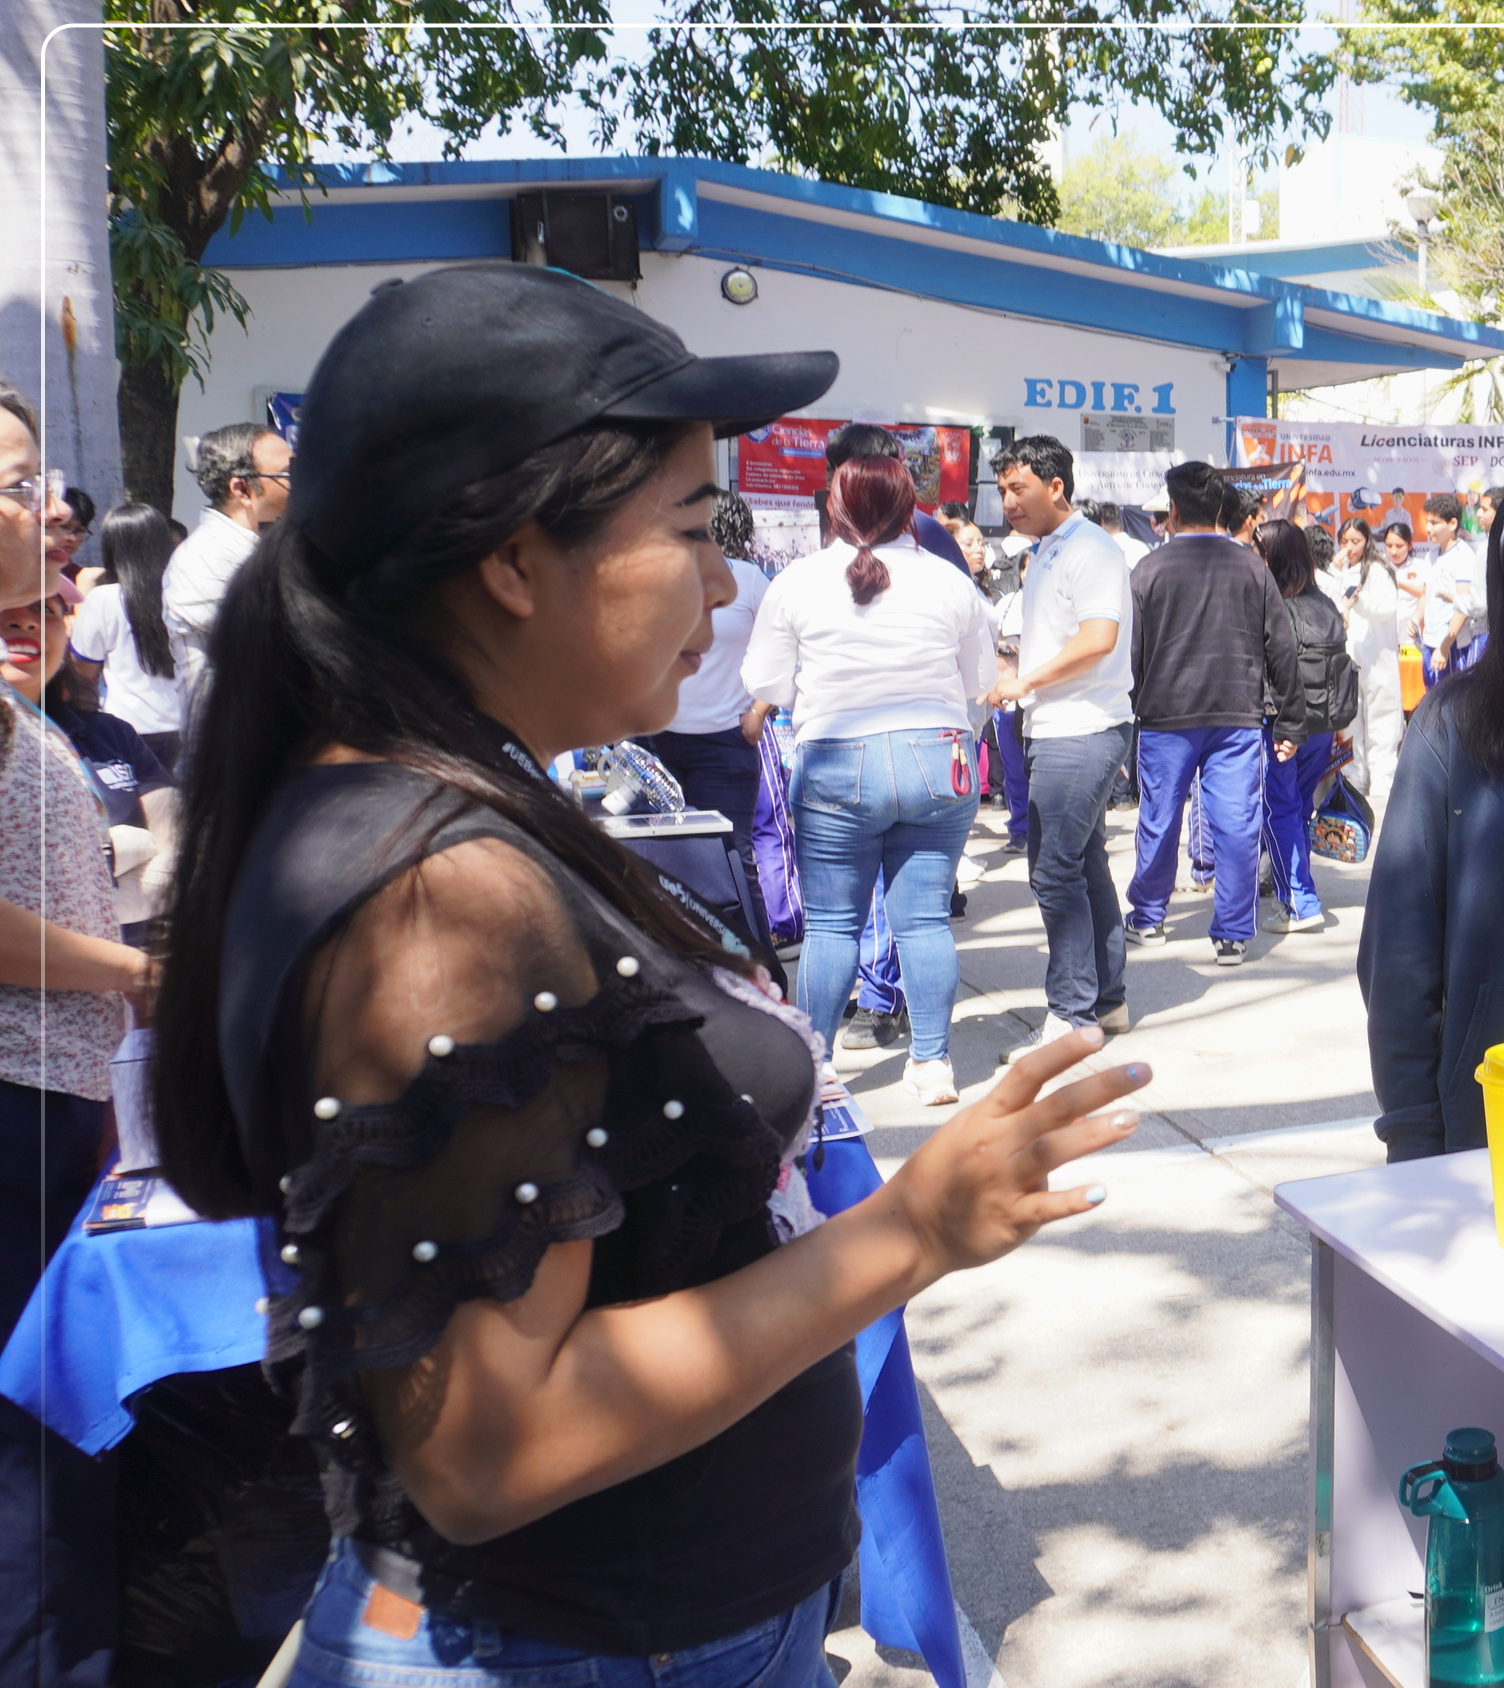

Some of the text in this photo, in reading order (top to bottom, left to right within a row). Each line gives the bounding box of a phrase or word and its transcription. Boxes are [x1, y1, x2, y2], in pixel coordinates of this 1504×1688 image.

[1024, 377, 1177, 414] EDIF. 1
[771, 423, 813, 438] Ciencias
[1280, 433, 1331, 442] UNIVERSIDAD
[794, 437, 825, 449] Tierra
[1360, 433, 1475, 448] Licenciaturas
[1280, 443, 1333, 464] INFA
[1453, 455, 1478, 467] SEP
[1262, 477, 1293, 490] Tierra
